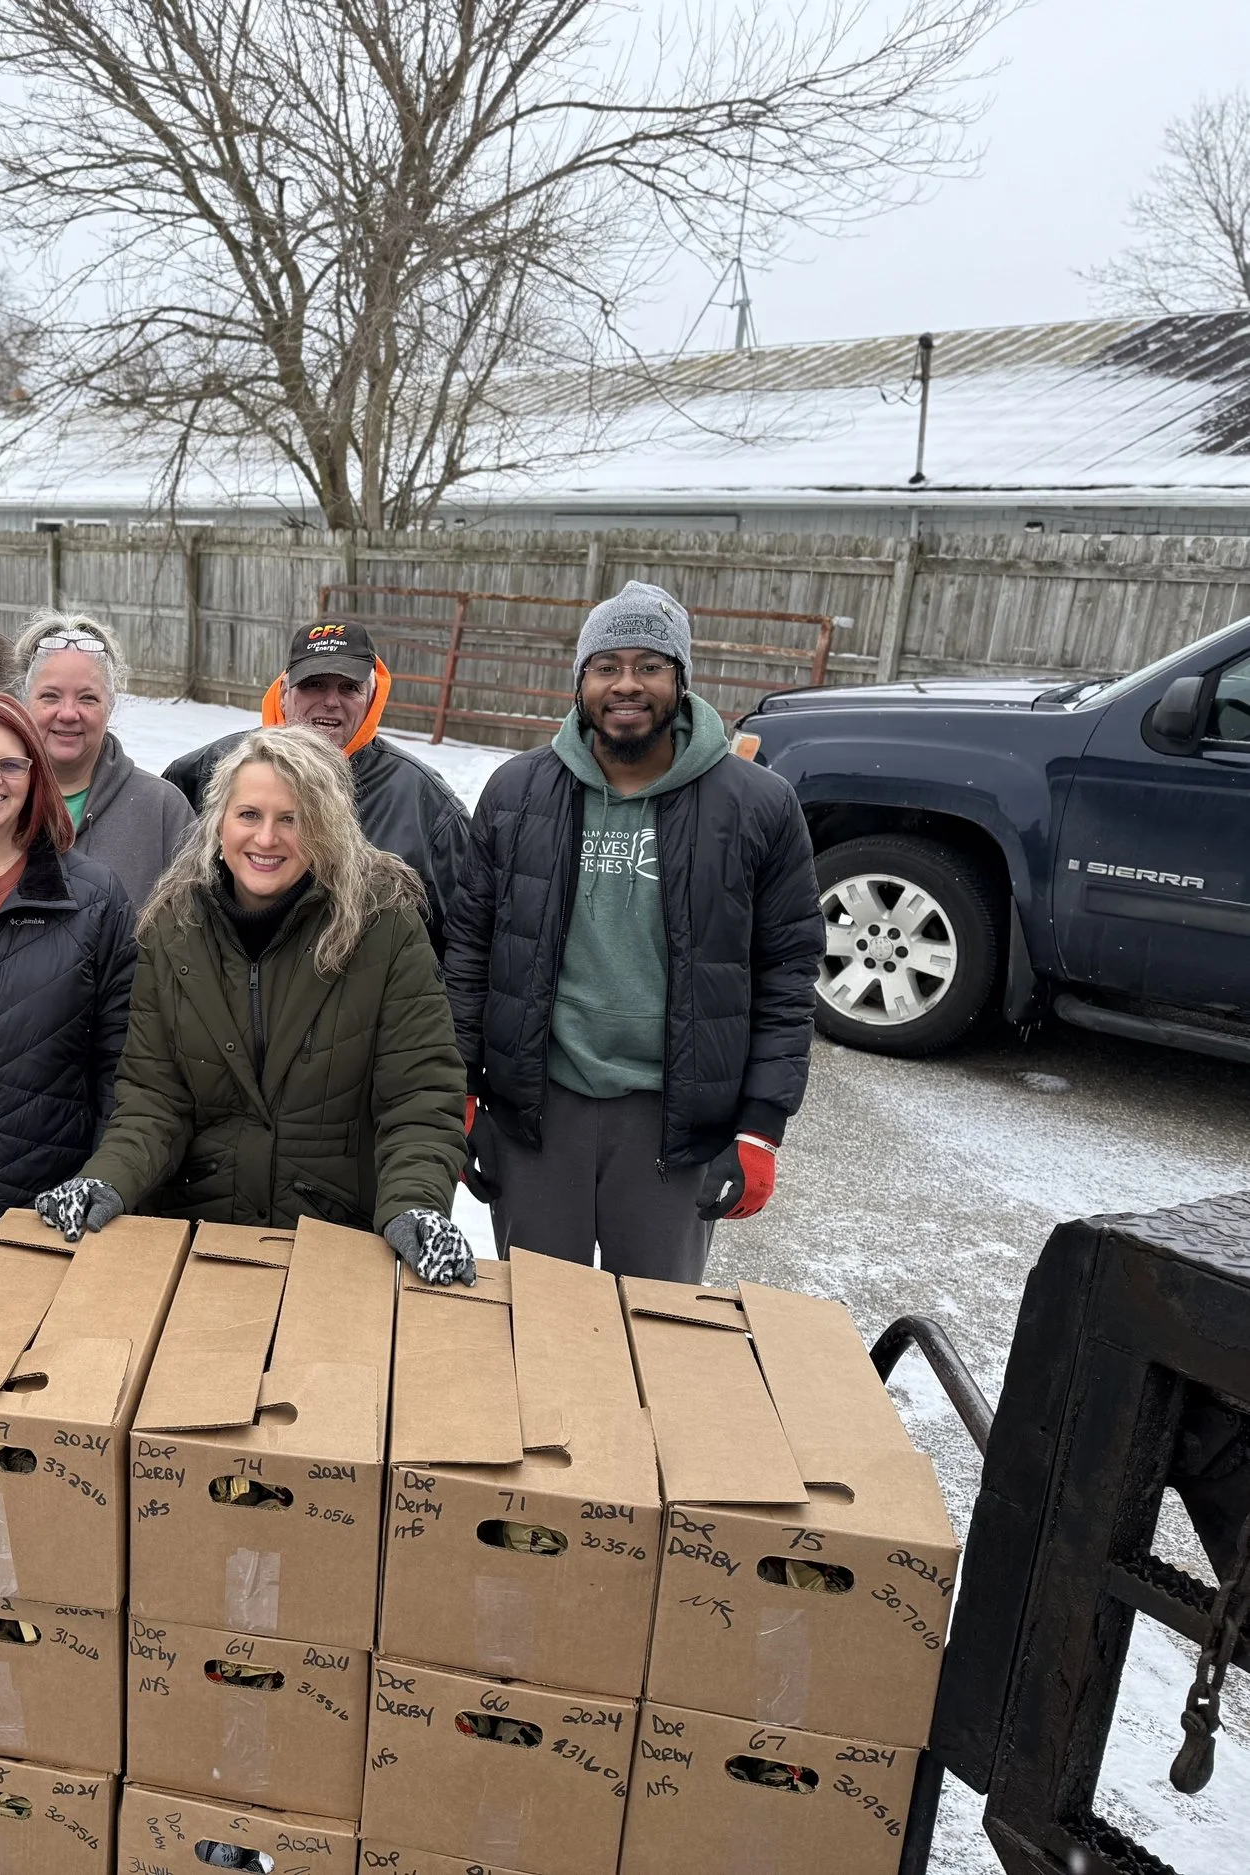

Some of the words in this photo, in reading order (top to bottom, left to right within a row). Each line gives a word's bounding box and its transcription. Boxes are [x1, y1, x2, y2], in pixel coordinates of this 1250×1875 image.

[614, 627, 641, 637] FISHES
[307, 640, 329, 650] Crystal
[581, 840, 629, 856] OAVES
[1087, 861, 1205, 890] SIERRA
[53, 1429, 111, 1457] 2024
[137, 1440, 177, 1461] Doe
[233, 1458, 263, 1476] 74
[307, 1463, 357, 1483] 2024
[403, 1471, 436, 1493] Doe
[395, 1493, 442, 1520] Derby
[498, 1491, 526, 1512] 71
[580, 1502, 635, 1524] 2024
[670, 1511, 716, 1543] Doe
[782, 1528, 825, 1551] 75
[887, 1550, 954, 1597] 2024
[133, 1620, 167, 1643] Doe
[129, 1637, 177, 1670] Derby
[225, 1638, 255, 1660] 64
[302, 1648, 350, 1671] 2024
[375, 1669, 416, 1694] Doe
[480, 1690, 510, 1712] 66
[561, 1707, 624, 1732] 2024
[652, 1714, 685, 1737] Doe
[749, 1728, 787, 1751] 67
[835, 1746, 896, 1768] 2024
[51, 1782, 99, 1800] 2024
[165, 1812, 186, 1842] Doe
[276, 1833, 332, 1856] 2024
[364, 1850, 400, 1867] Doe
